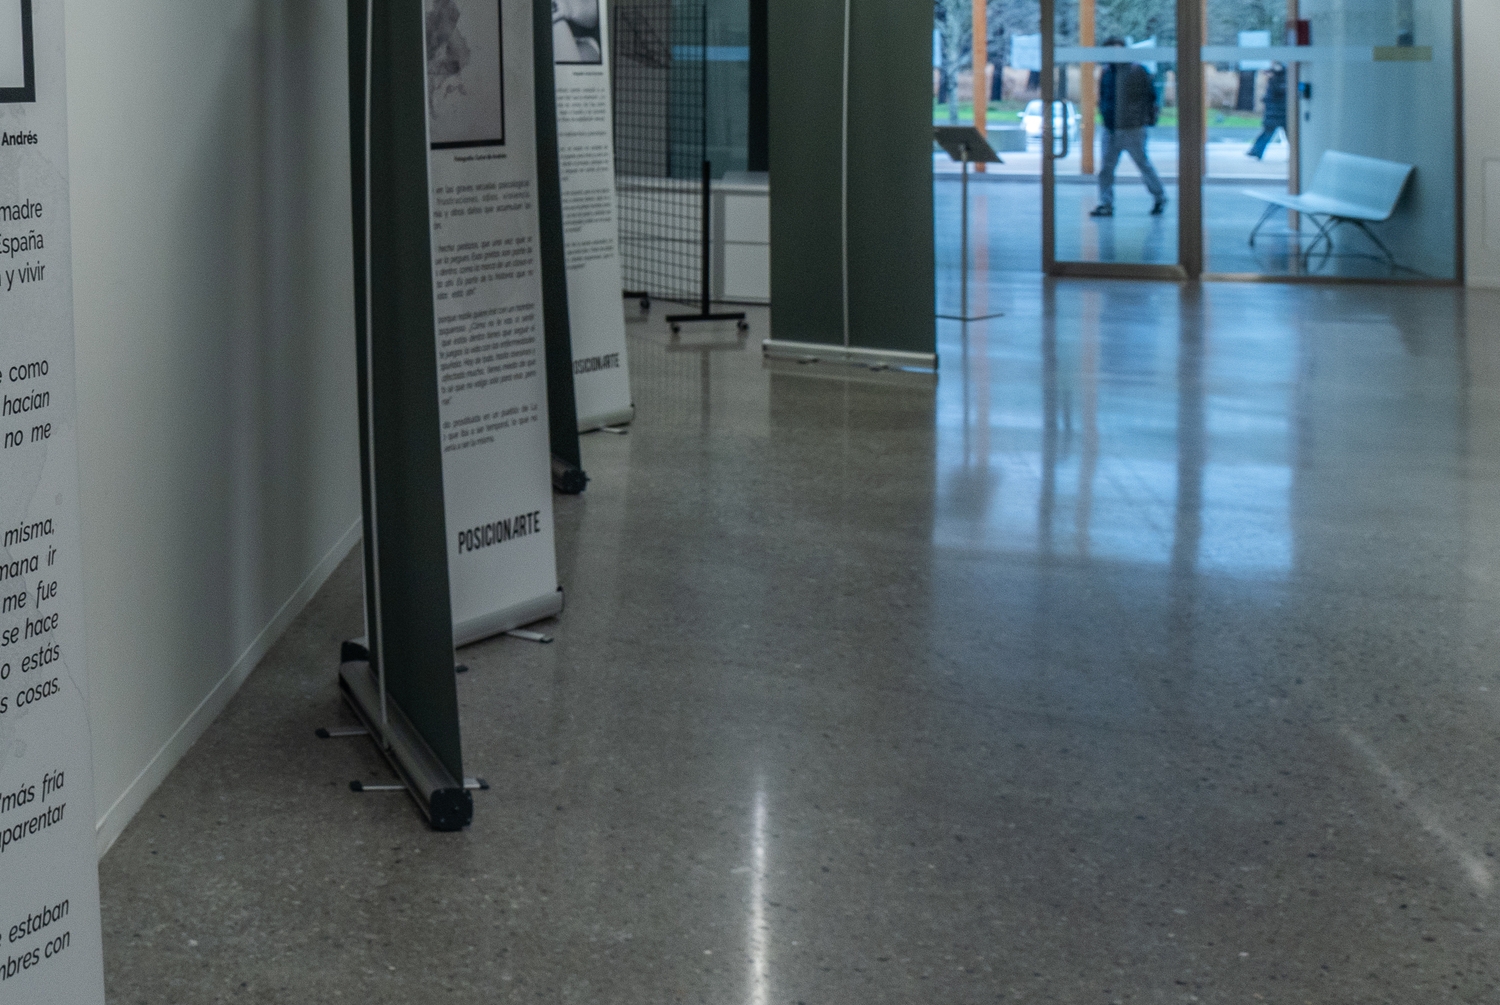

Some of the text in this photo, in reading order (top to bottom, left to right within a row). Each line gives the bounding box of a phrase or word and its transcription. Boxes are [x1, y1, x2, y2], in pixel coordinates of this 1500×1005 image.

[1, 131, 38, 146] Andrés
[5, 270, 14, 291] y
[18, 261, 45, 283] vivir
[3, 389, 50, 416] hacían
[4, 519, 54, 547] misma,
[458, 510, 541, 554] POSICIONARTE
[2, 592, 27, 613] me
[36, 580, 57, 608] fue
[16, 678, 60, 707] cosas.
[42, 770, 64, 802] fría
